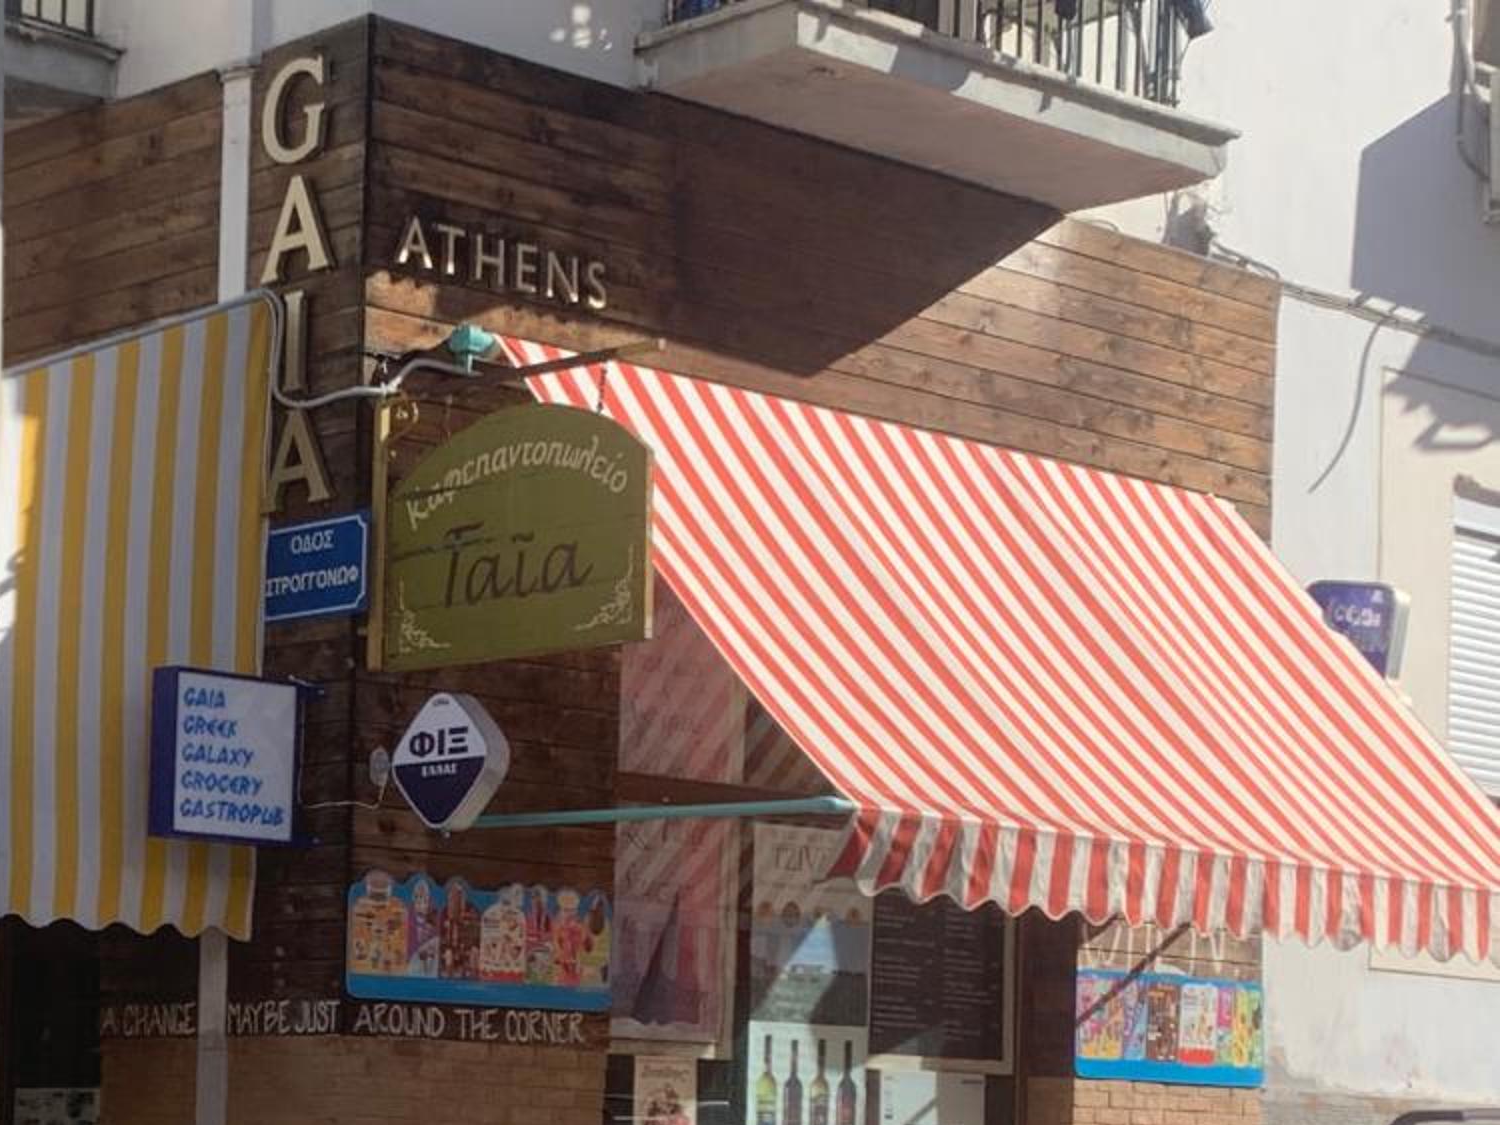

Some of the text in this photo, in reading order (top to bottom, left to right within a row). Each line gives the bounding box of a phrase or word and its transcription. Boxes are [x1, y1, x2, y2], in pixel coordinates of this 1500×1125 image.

[396, 216, 608, 310] ATHENS
[261, 53, 336, 513] GAIA
[290, 529, 336, 555] ΟΔΟΣ
[182, 687, 226, 708] GAIA
[182, 715, 238, 739] GREEK
[181, 742, 254, 768] GALAXY
[409, 726, 468, 757] ΦΙΞ
[180, 769, 263, 796] GROCERY
[179, 798, 286, 827] GASTROPUB
[122, 1001, 197, 1036] CHANGE
[227, 999, 292, 1036] MAYBE
[293, 1000, 341, 1035] JUST
[352, 1001, 446, 1039] AROUND
[453, 1006, 500, 1041] THE
[504, 1009, 587, 1044] CORNER
